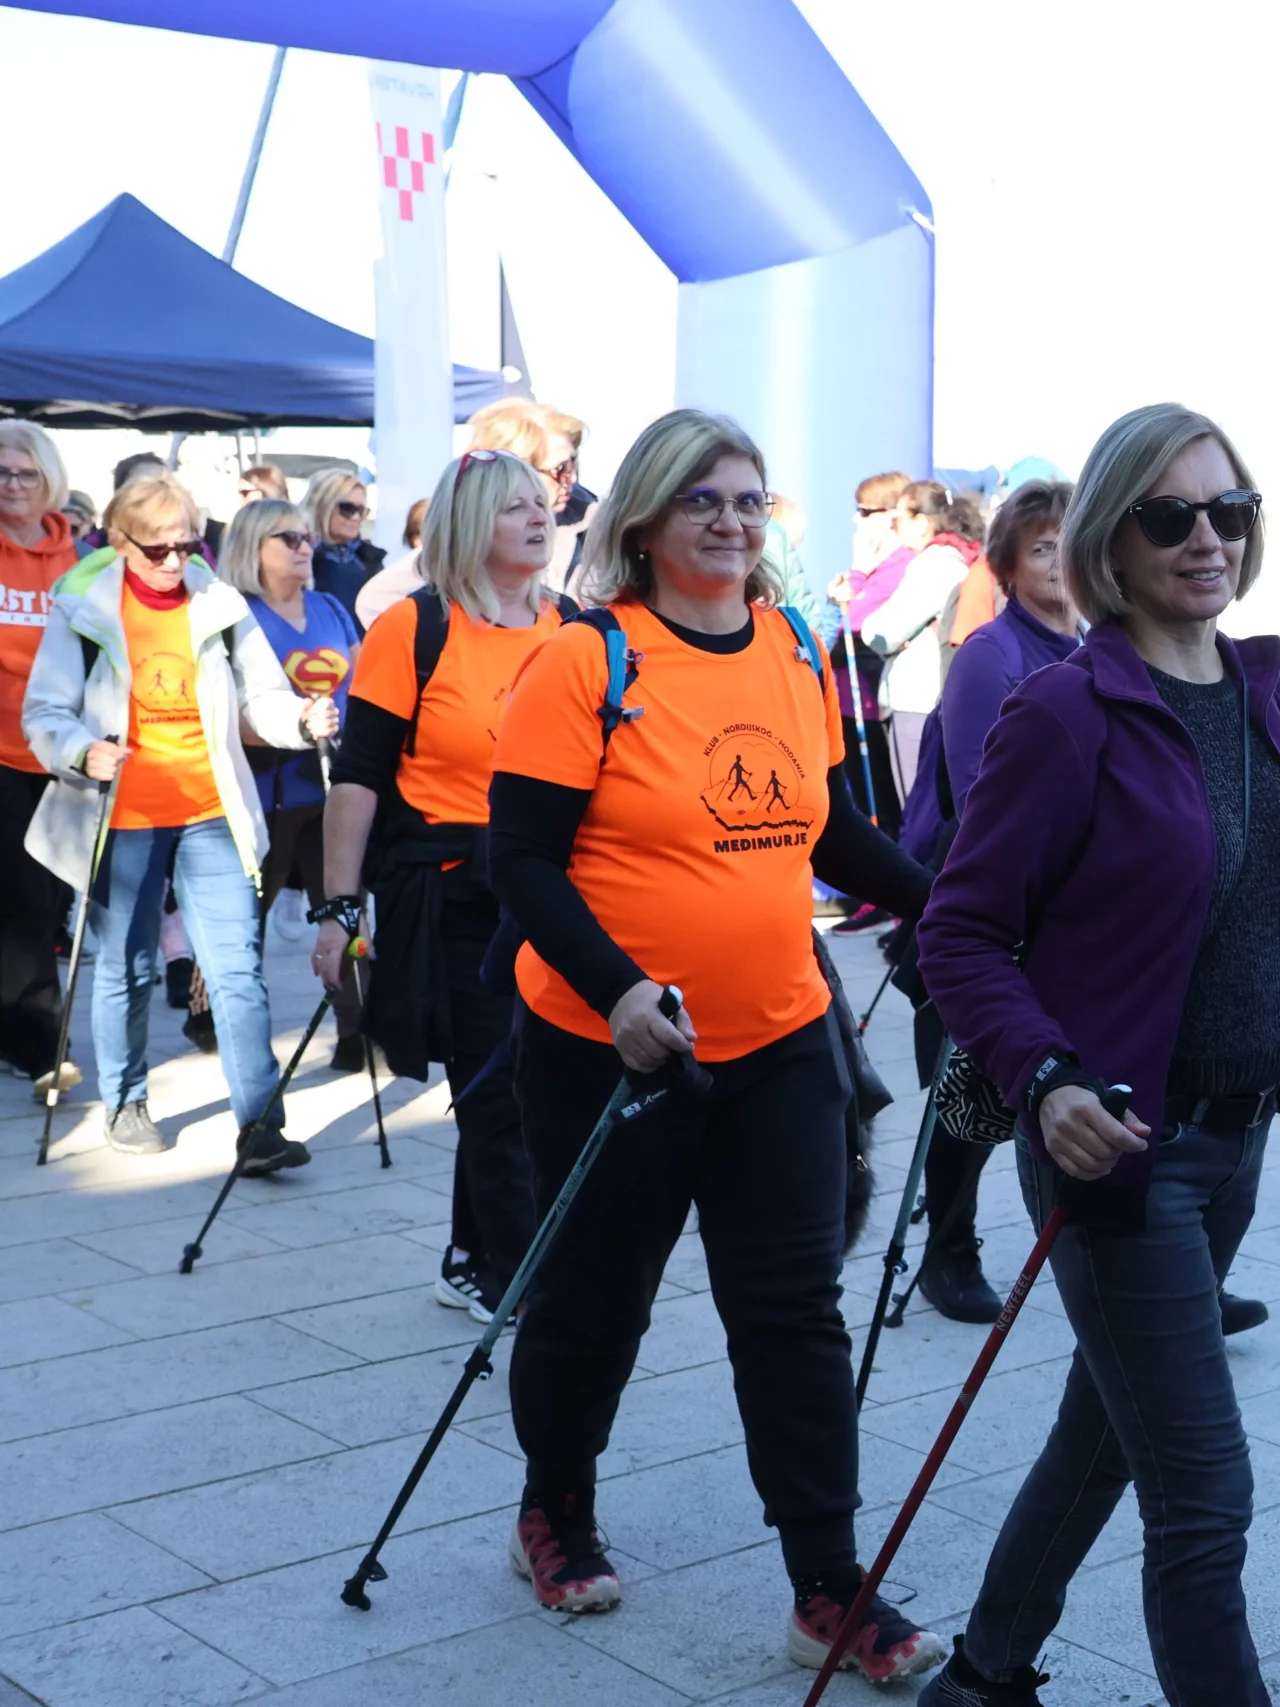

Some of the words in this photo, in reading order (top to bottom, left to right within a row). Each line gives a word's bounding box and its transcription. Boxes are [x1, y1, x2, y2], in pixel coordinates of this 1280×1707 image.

[703, 735, 720, 757] KLUB
[778, 739, 806, 779] HODANJA
[995, 1273, 1034, 1332] NEWFEEL
